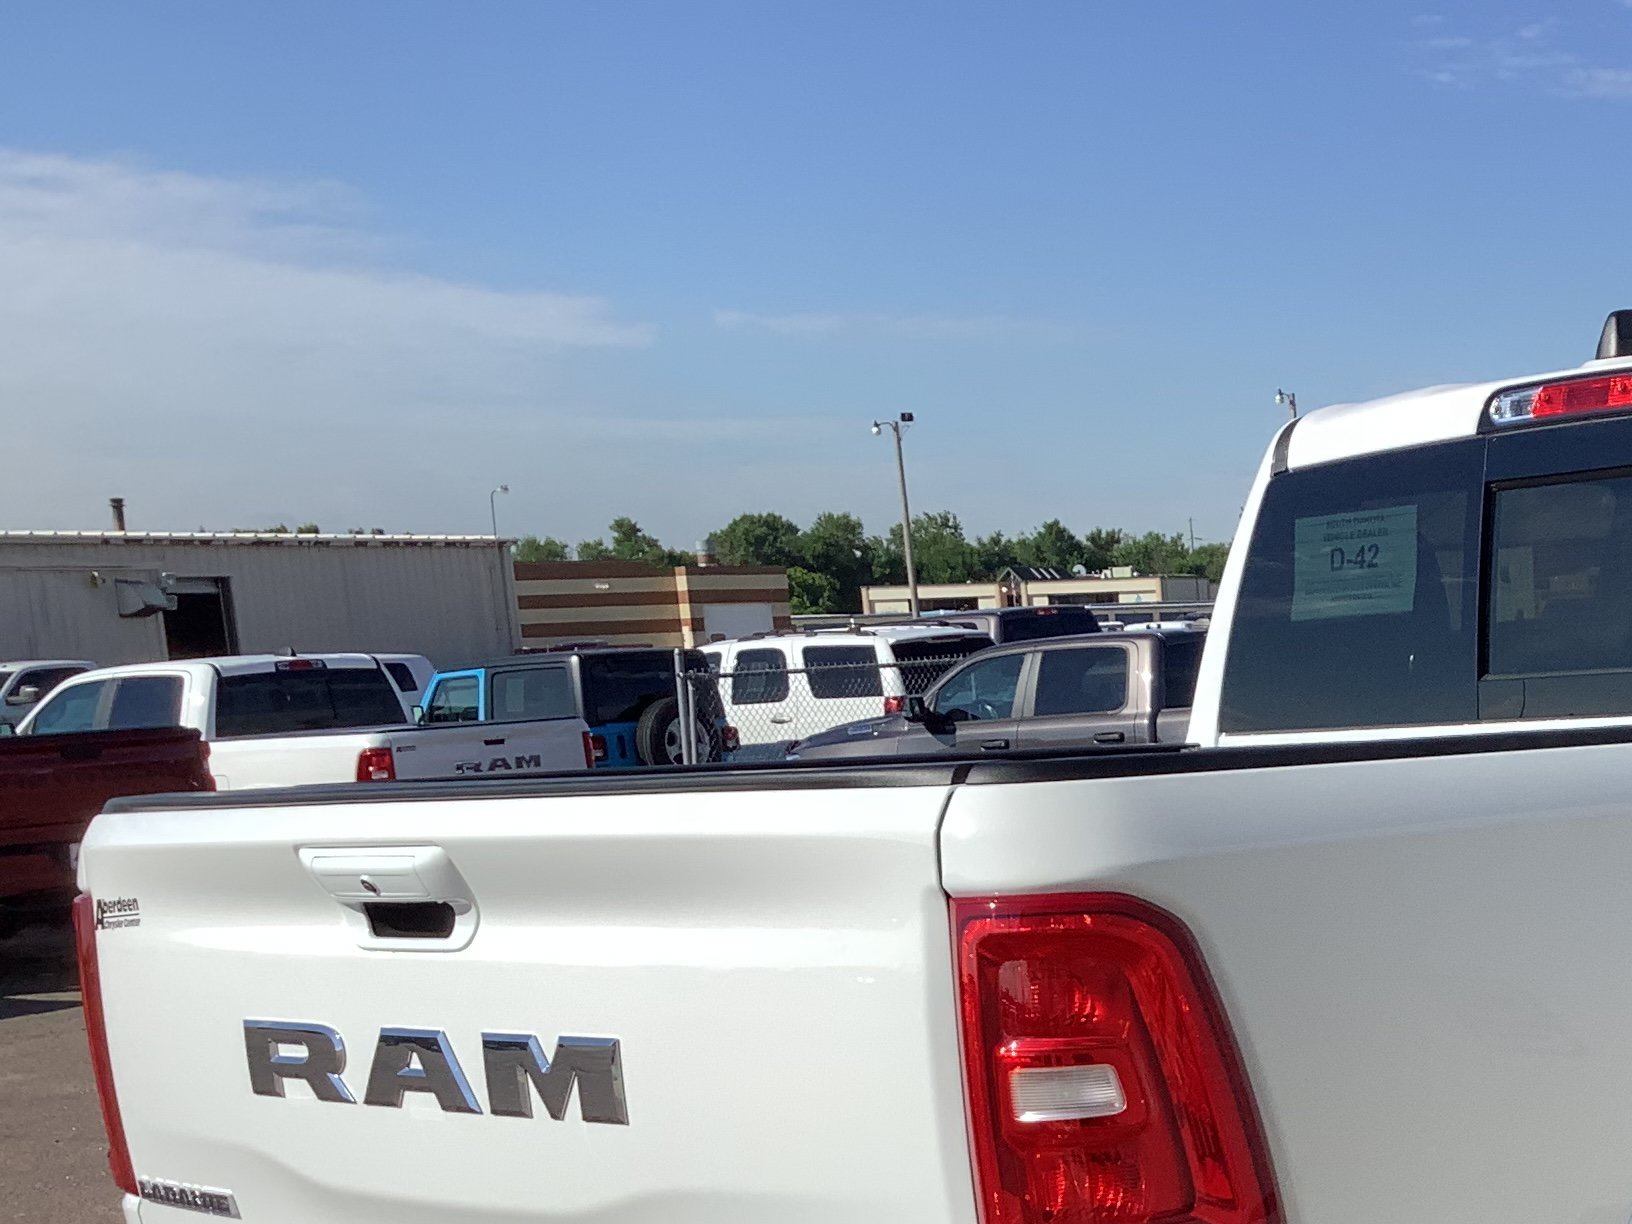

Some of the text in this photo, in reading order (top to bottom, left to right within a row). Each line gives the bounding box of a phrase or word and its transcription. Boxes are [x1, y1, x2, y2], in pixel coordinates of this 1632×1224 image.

[1330, 543, 1380, 572] D-42
[455, 754, 541, 774] RAM
[95, 897, 139, 930] Aberdeen
[242, 1016, 630, 1126] RAM
